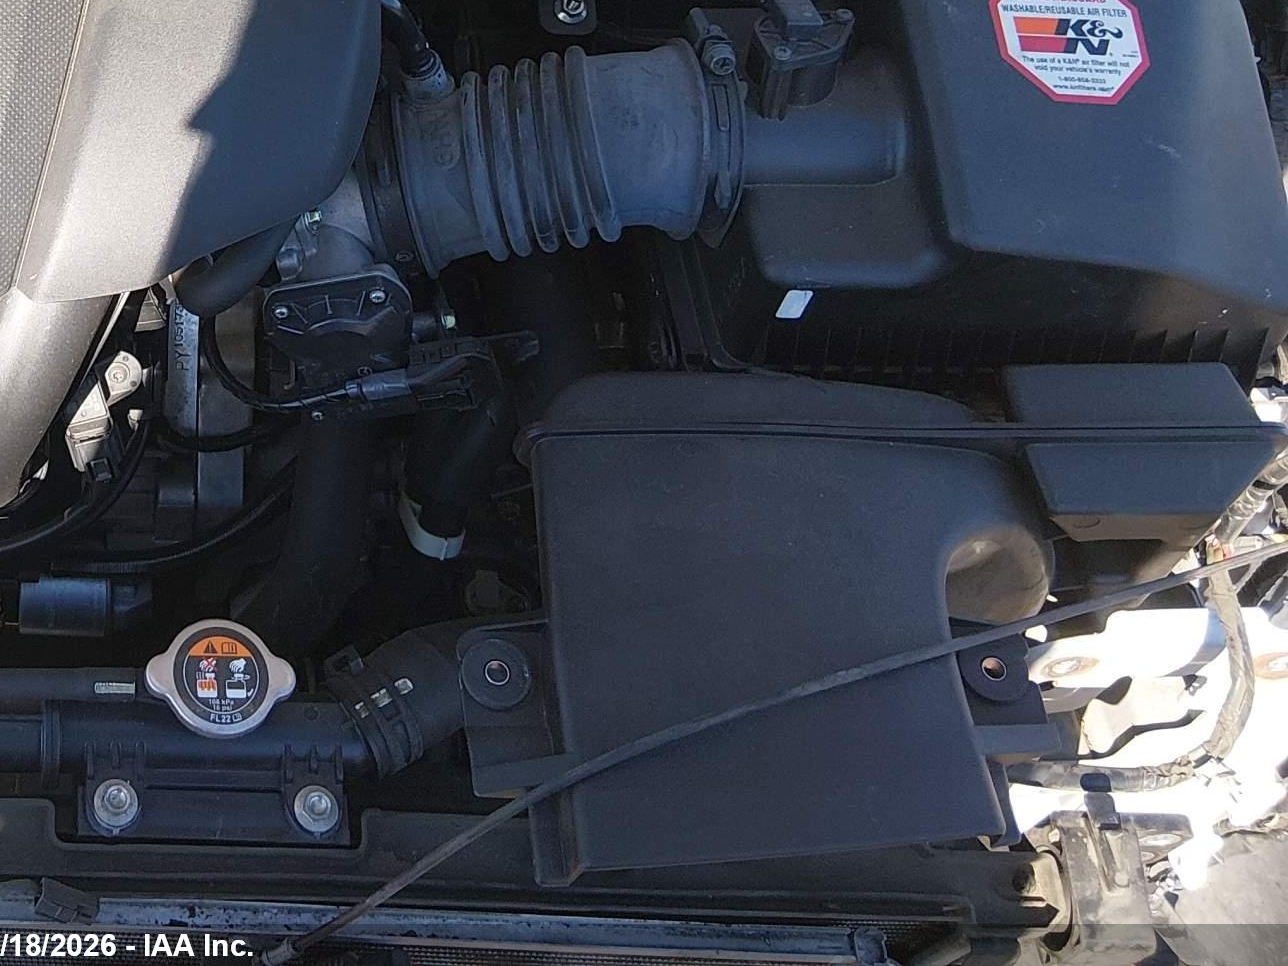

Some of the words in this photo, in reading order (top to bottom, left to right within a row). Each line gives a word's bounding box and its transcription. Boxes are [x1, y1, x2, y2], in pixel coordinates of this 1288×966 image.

[1001, 4, 1086, 16] WASHABLE/REUSABLE
[1087, 8, 1100, 16] AIR
[1102, 9, 1128, 18] FILTER
